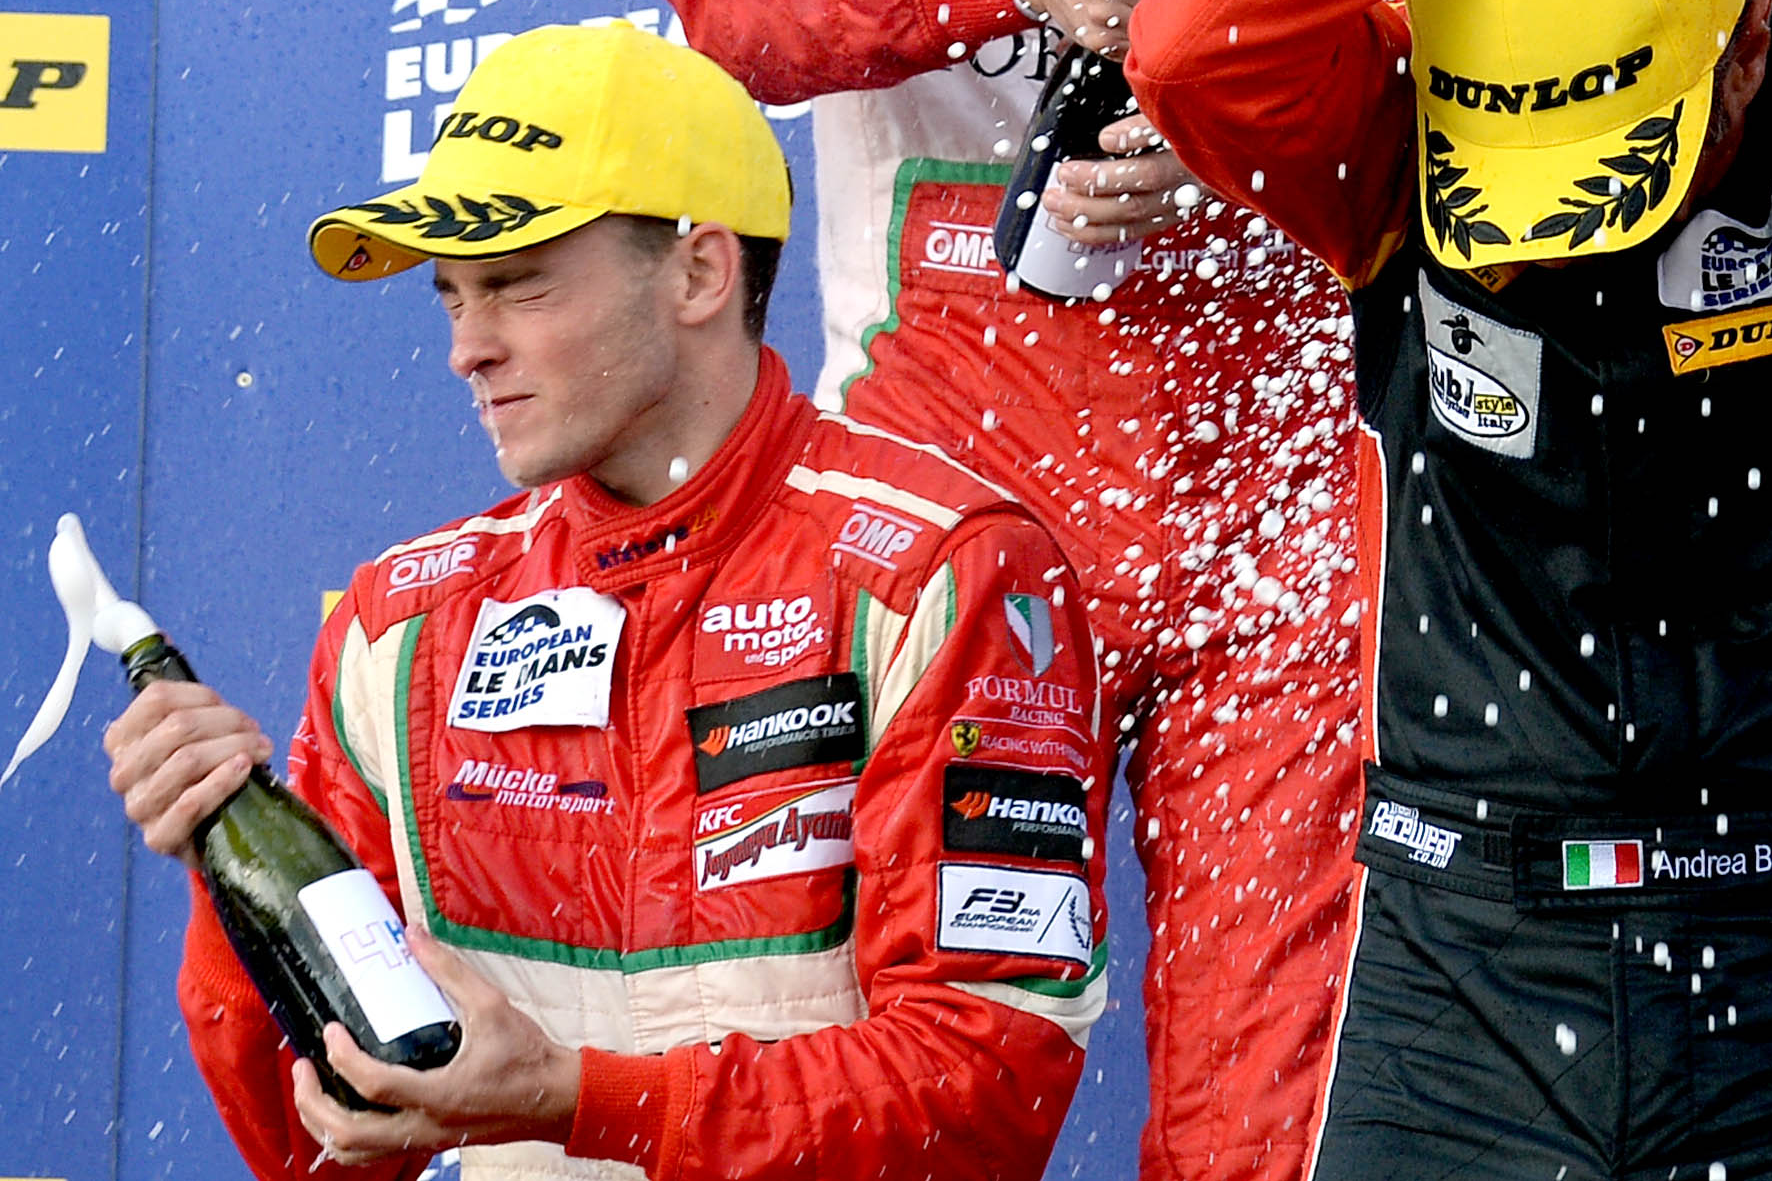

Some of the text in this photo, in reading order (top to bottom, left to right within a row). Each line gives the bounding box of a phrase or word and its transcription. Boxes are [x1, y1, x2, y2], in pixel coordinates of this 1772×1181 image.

[1429, 46, 1653, 114] DUNLOP
[1702, 271, 1736, 292] LE
[1477, 399, 1513, 412] style
[1478, 415, 1514, 431] Italy
[839, 512, 915, 560] OMP
[389, 544, 477, 586] OMP
[701, 595, 813, 633] auto
[475, 624, 593, 667] EUROPEAN
[723, 612, 818, 651] motor
[764, 627, 825, 667] sport
[465, 643, 609, 694] LE MANS
[457, 683, 545, 719] SERIES
[1009, 706, 1065, 725] RACING
[980, 734, 1029, 754] RACING
[453, 760, 559, 793] Mücke
[495, 788, 617, 816] motorsport
[698, 804, 743, 835] KFC
[1654, 848, 1748, 880] Andrea
[961, 888, 1026, 914] F3
[954, 912, 1039, 927] EUROPEAN
